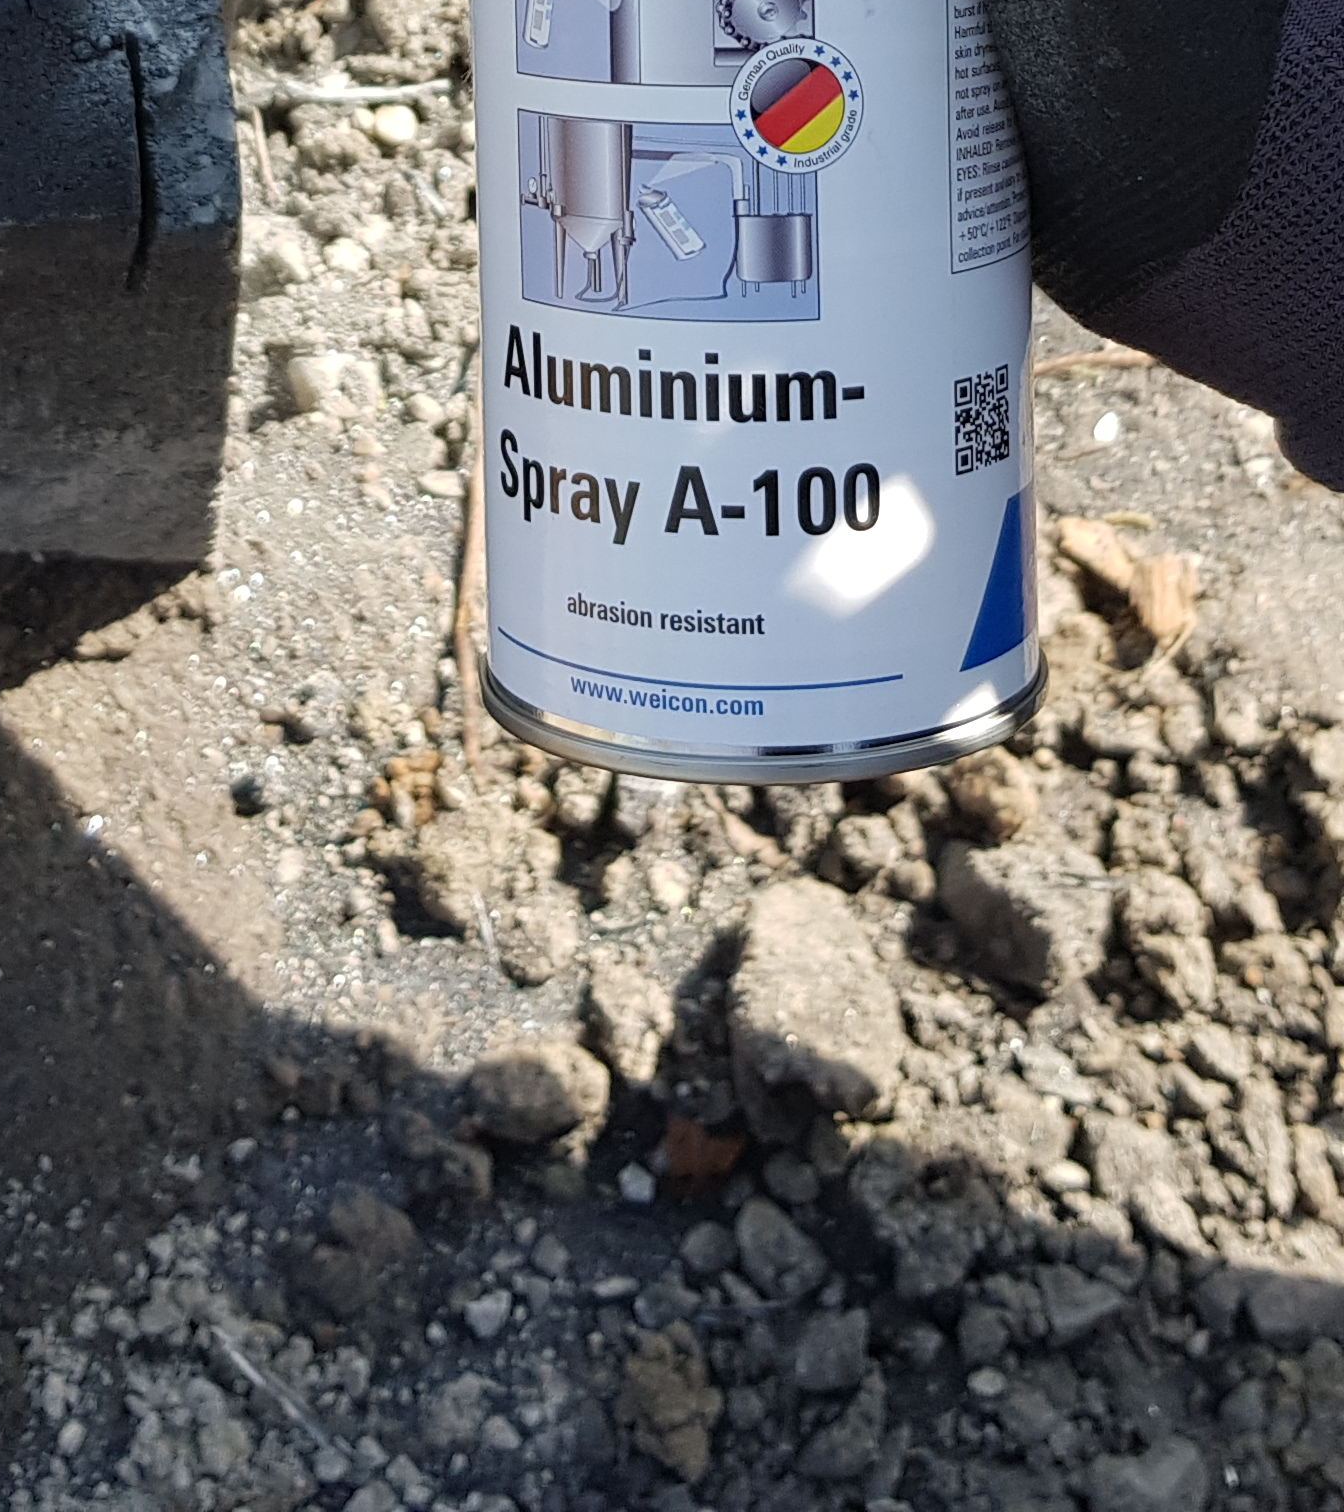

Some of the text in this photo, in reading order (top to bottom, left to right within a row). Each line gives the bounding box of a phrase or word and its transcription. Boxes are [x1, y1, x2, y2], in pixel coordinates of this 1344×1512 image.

[954, 45, 972, 60] skin
[738, 43, 805, 101] German Quality
[954, 66, 969, 80] hot
[955, 87, 969, 101] not
[955, 105, 975, 121] after
[793, 109, 858, 168] Industrial grade
[956, 123, 980, 142] Avoid
[956, 140, 993, 162] INHALED:
[956, 164, 981, 182] EYES:
[964, 182, 993, 204] present
[958, 246, 996, 263] collection
[504, 324, 865, 423] Aluminium-
[500, 429, 880, 545] Spray A-100
[567, 593, 765, 635] abrasion resistant
[570, 676, 765, 716] www.weicon.com
